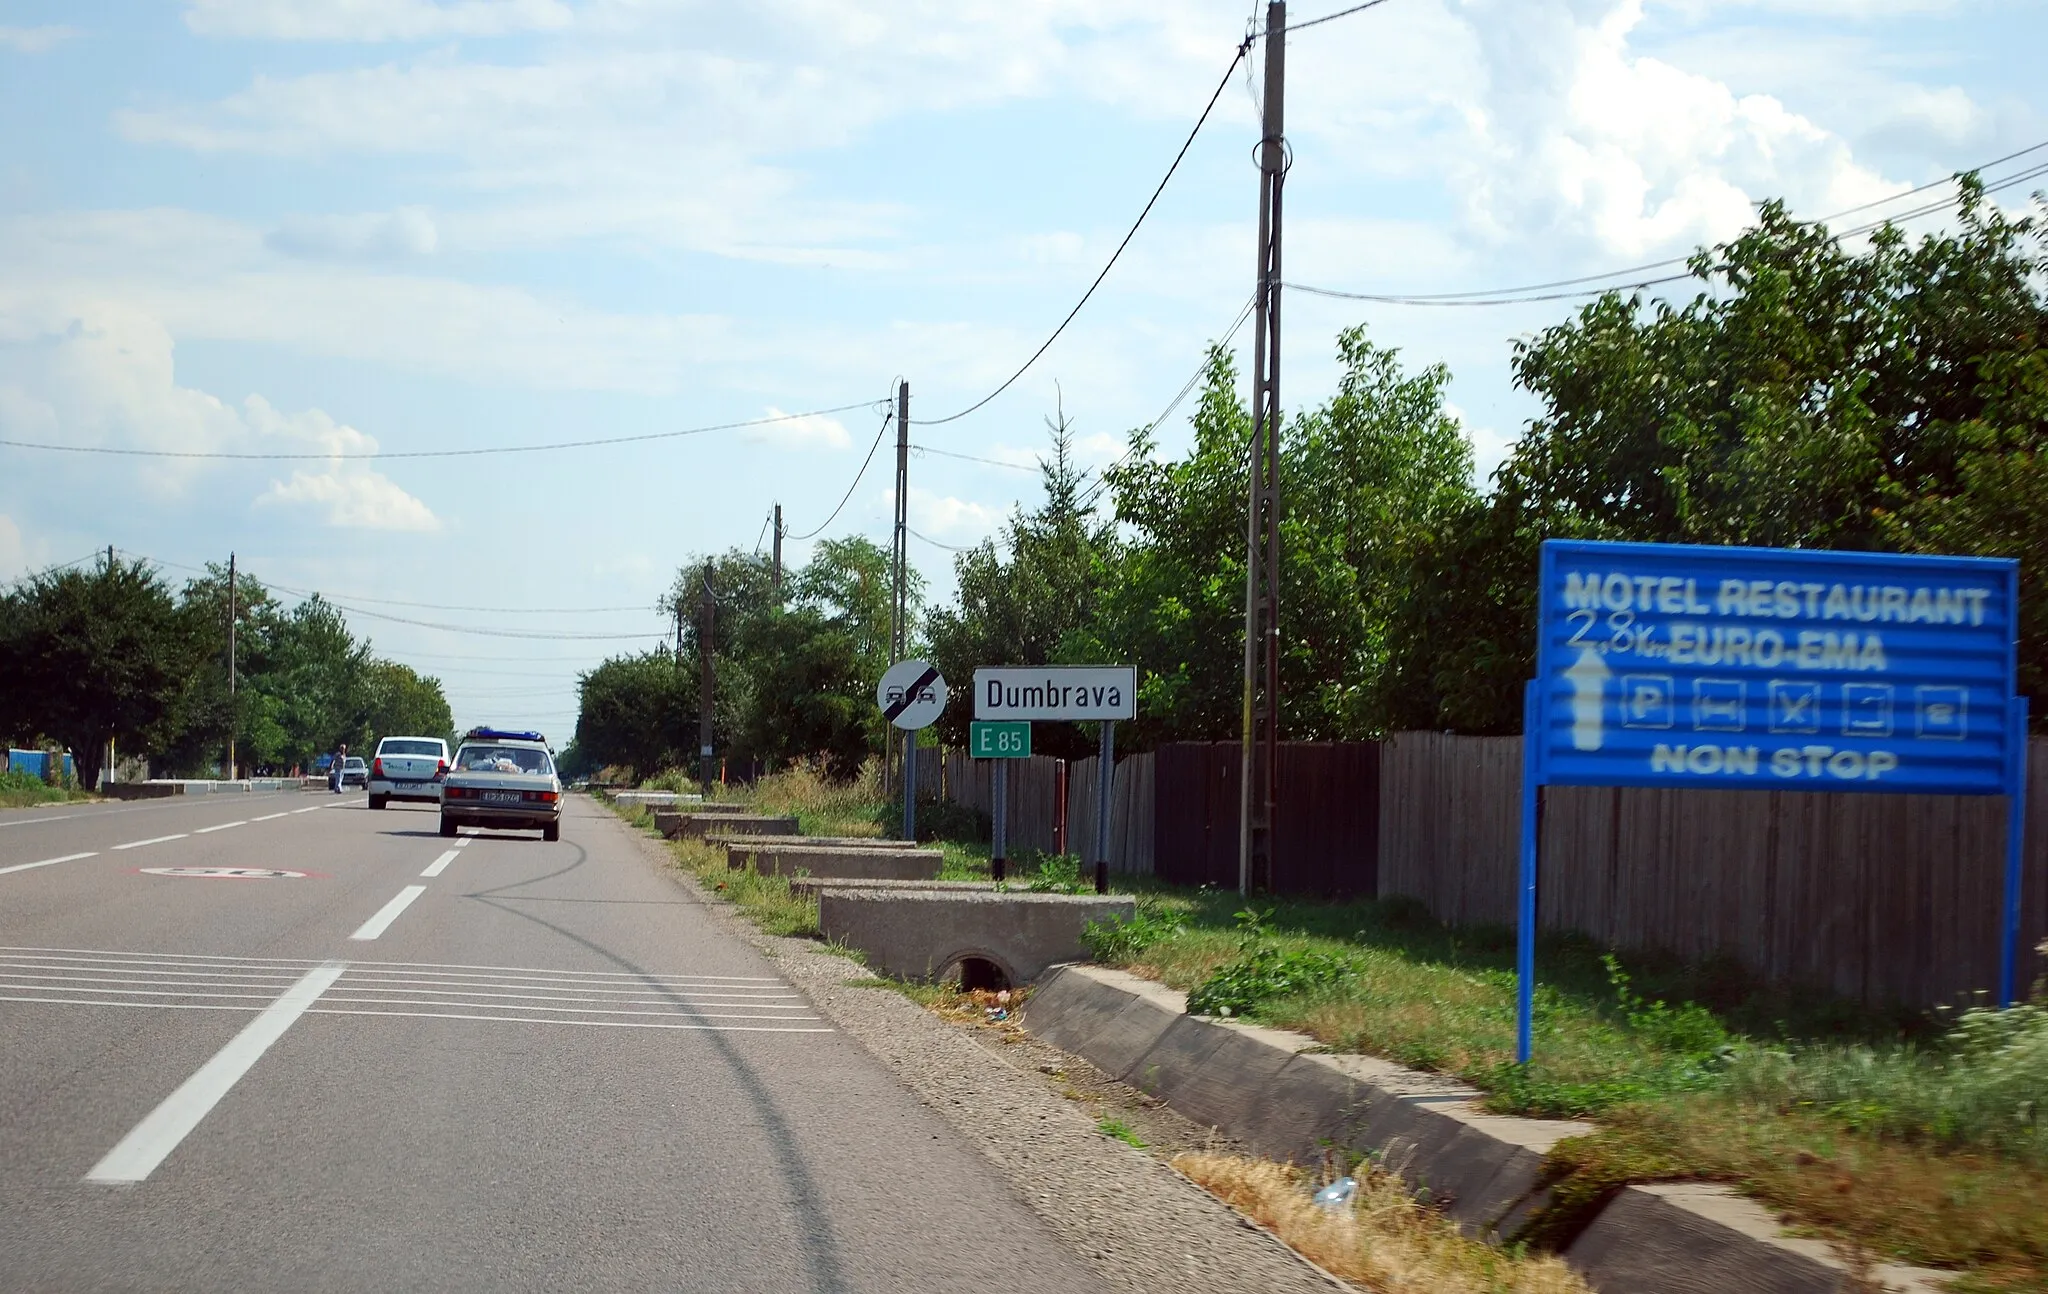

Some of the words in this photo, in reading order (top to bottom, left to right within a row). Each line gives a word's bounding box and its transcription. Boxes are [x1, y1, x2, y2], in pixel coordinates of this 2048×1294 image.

[1564, 572, 1711, 615] MOTEL
[1718, 579, 1991, 626] RESTAURANT
[1669, 626, 1886, 671] EURO-EMA
[987, 680, 1121, 708] Dumbrava
[980, 728, 993, 751] E
[998, 731, 1022, 751] 85
[1650, 743, 1760, 776] NON
[1770, 746, 1898, 781] STOP
